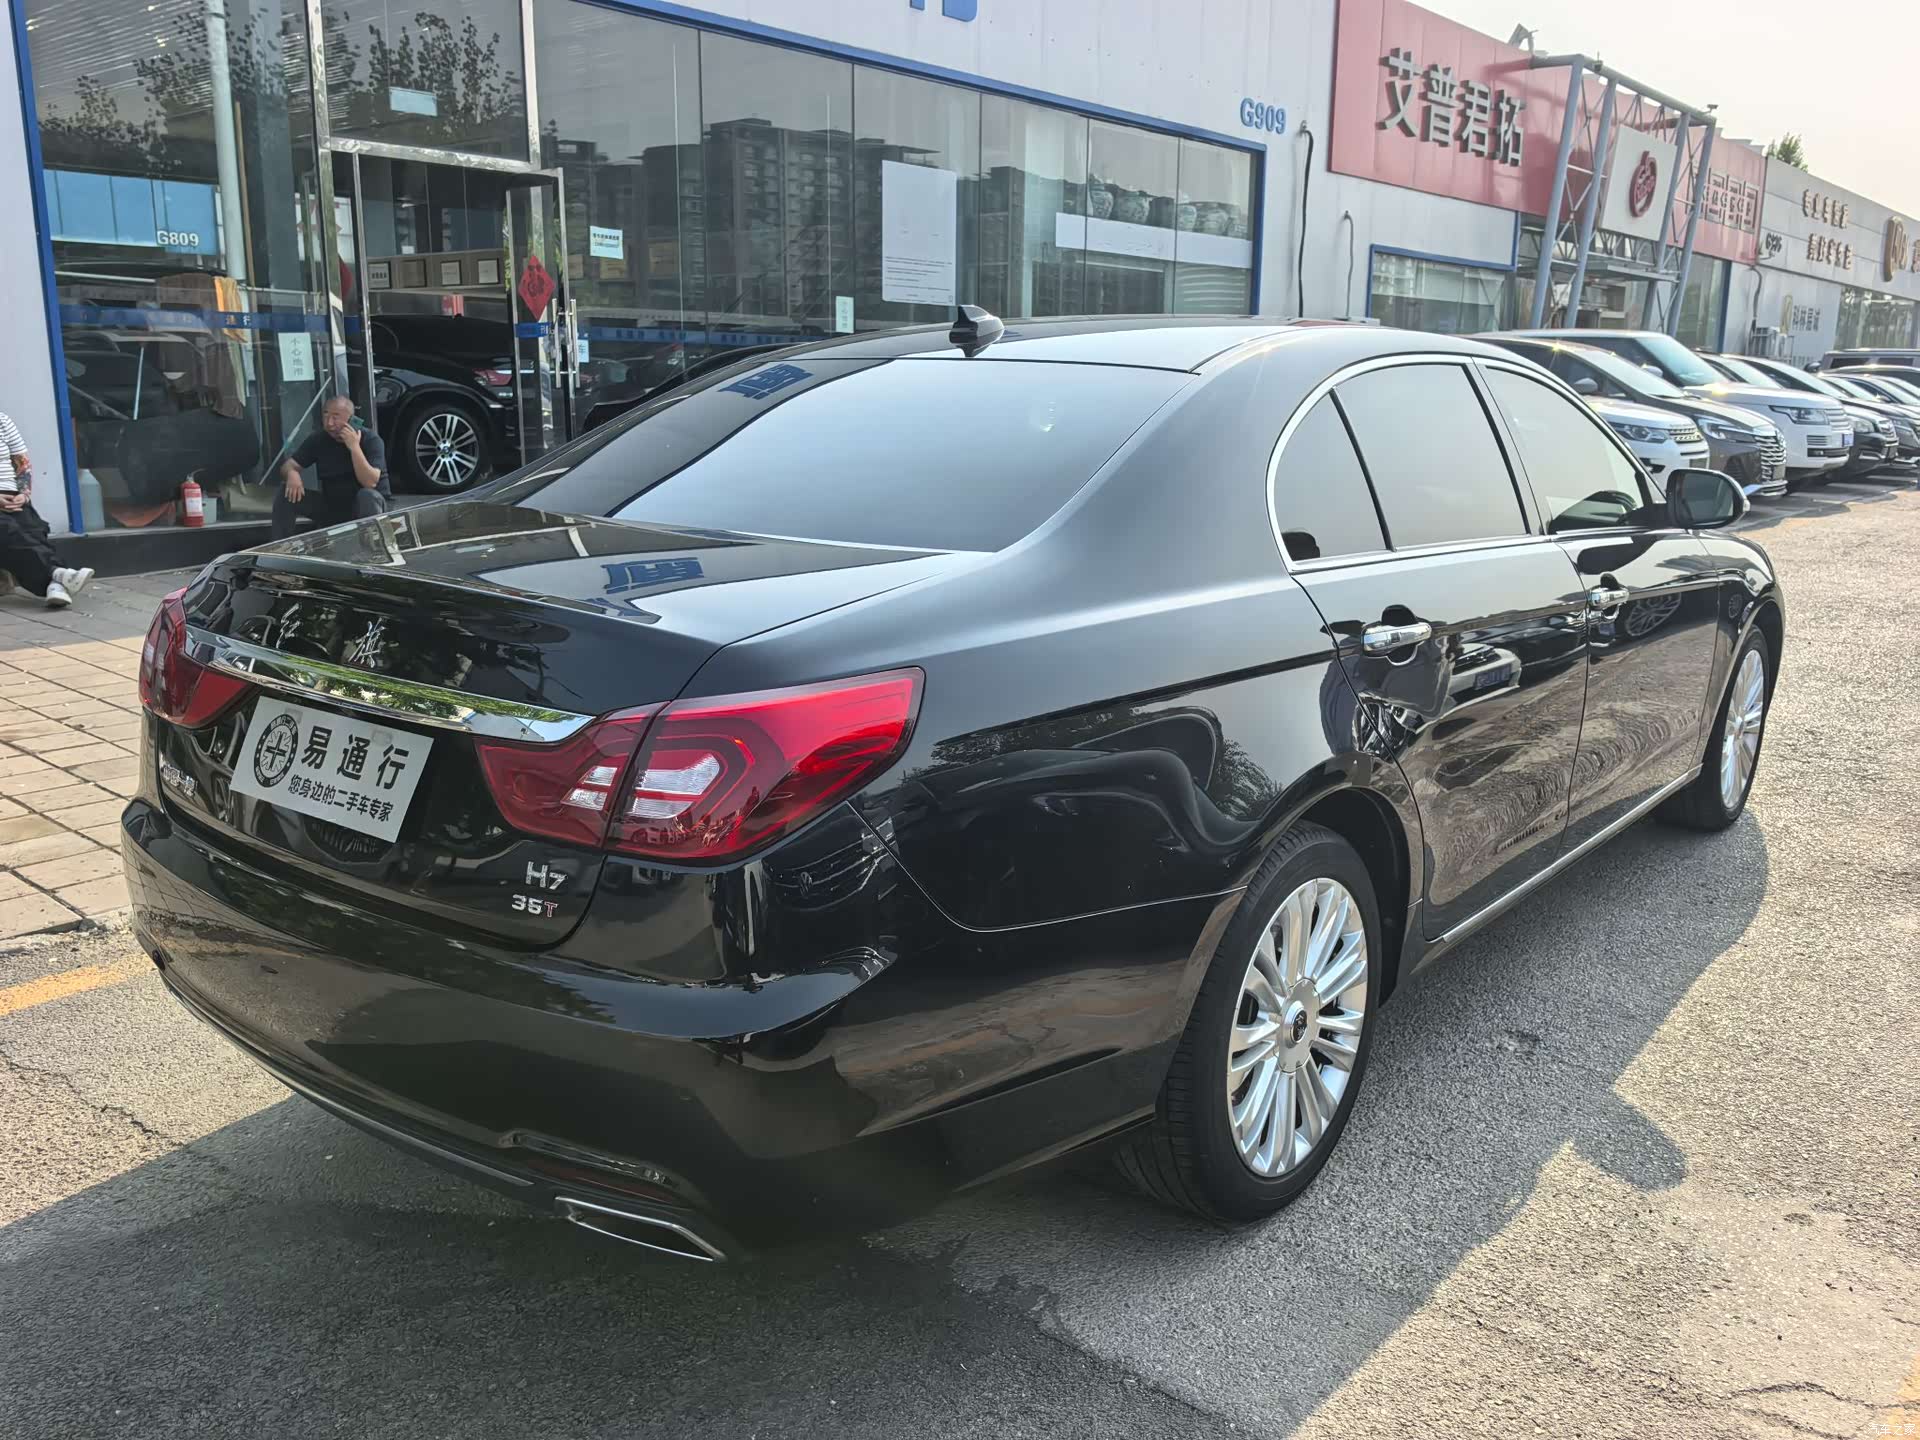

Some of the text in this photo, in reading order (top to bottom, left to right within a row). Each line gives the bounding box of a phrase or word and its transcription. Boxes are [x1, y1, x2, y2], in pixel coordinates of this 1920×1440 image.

[1240, 97, 1287, 135] G909
[1380, 47, 1525, 168] 艾普君拓
[156, 229, 200, 247] G809
[276, 602, 387, 669] 红旗
[300, 724, 411, 791] 易通行
[287, 773, 395, 823] 您身边的二手车专家
[525, 860, 569, 891] H7
[511, 893, 560, 918] 35T
